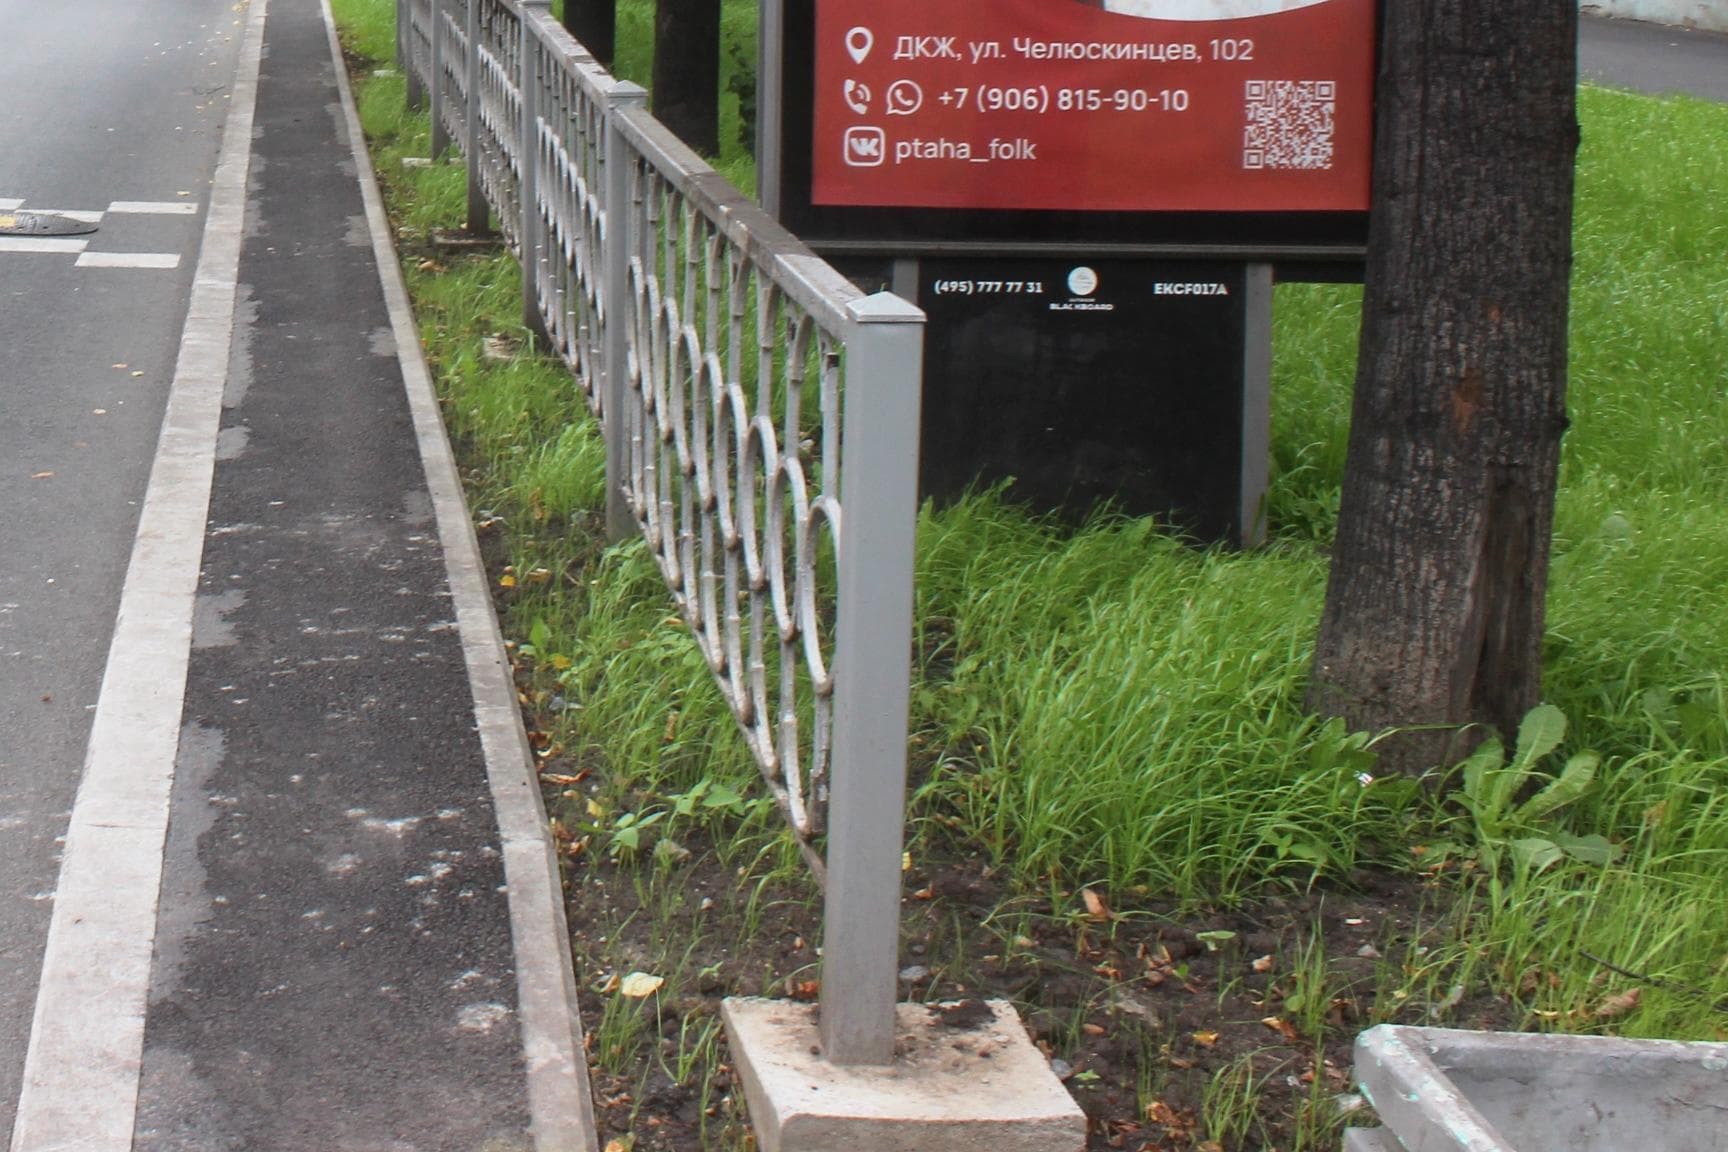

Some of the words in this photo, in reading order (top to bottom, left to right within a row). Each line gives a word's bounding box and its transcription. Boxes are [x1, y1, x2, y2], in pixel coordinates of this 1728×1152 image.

[893, 36, 962, 61] ДКЖ,
[969, 41, 1007, 64] ул.
[1013, 38, 1202, 63] Челюскинцев,
[1210, 39, 1254, 61] 102
[938, 87, 969, 109] +7
[977, 85, 1049, 113] (906)
[1057, 88, 1189, 111] 815-90-10
[895, 138, 1037, 164] ptaha_folk
[934, 279, 974, 295] (495)
[976, 281, 1003, 293] 777
[1005, 281, 1024, 293] 77
[1026, 281, 1043, 293] 31
[1048, 303, 1115, 311] BLACKBOARD
